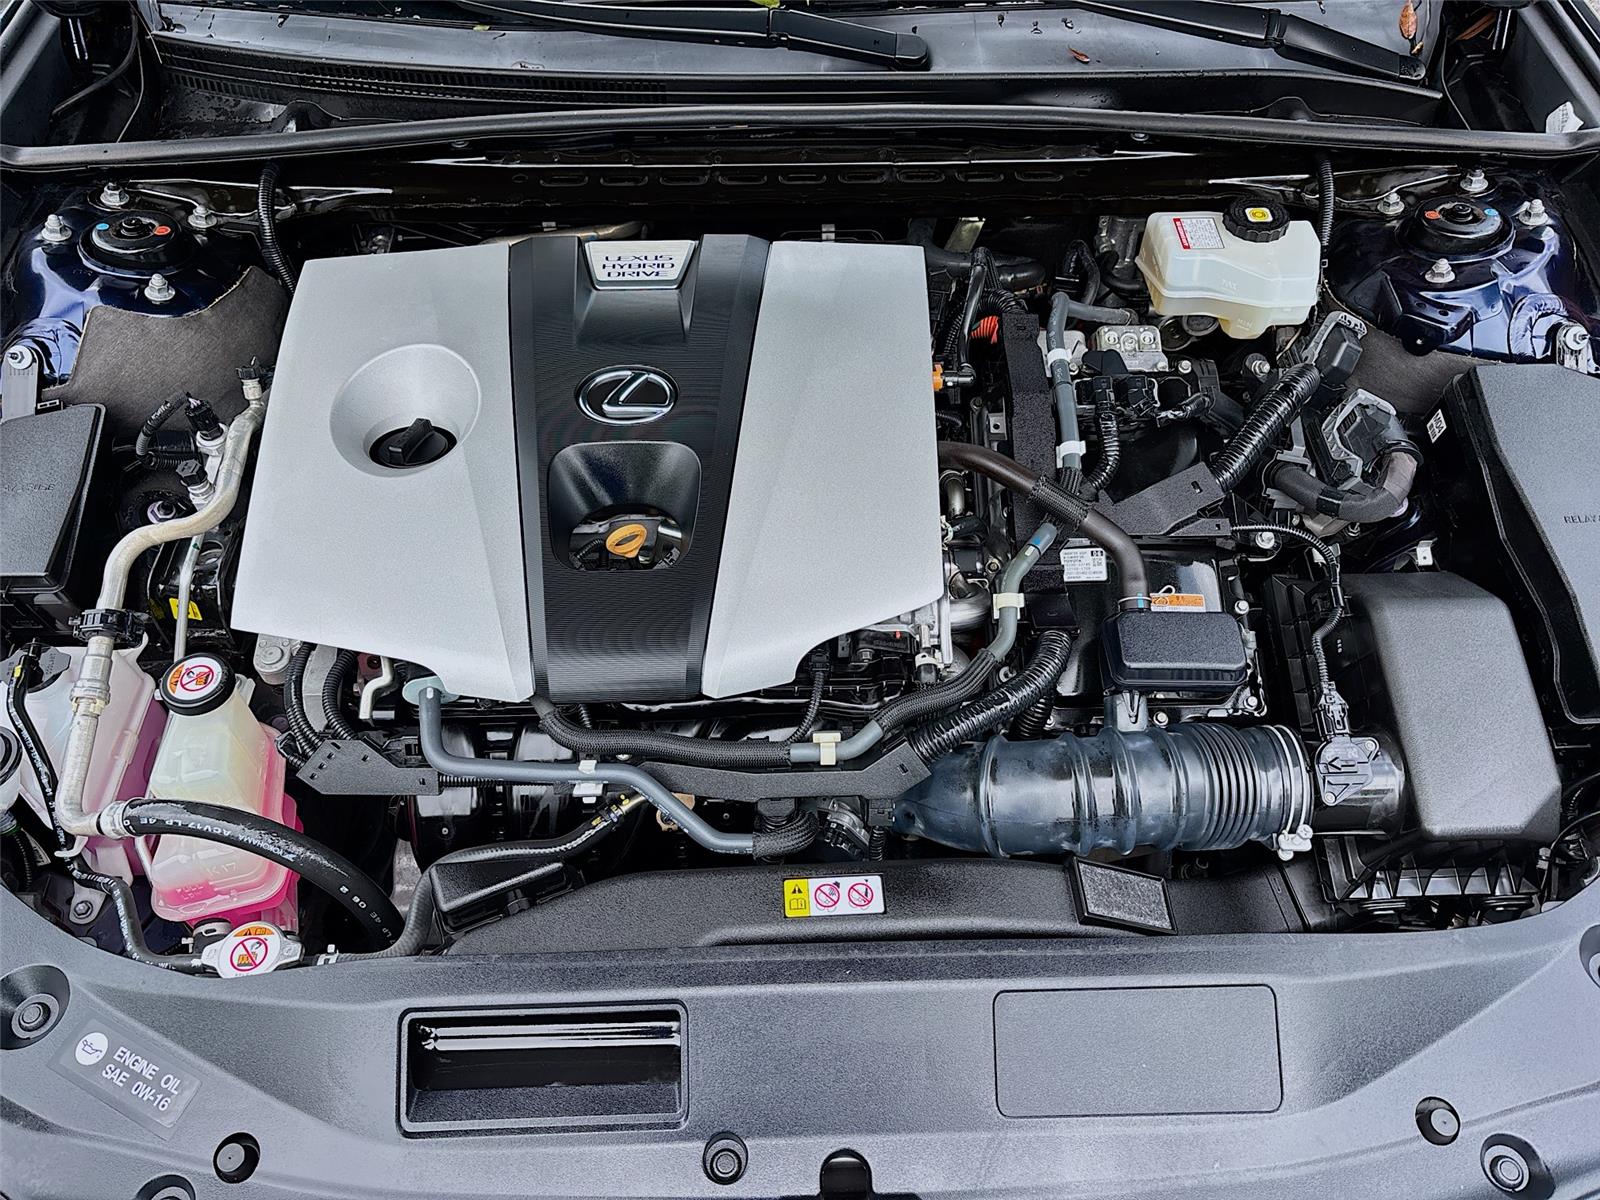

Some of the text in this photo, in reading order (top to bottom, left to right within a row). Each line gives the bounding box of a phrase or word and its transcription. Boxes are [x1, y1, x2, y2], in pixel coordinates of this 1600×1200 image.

[602, 262, 675, 270] HYBRID
[607, 270, 669, 278] DRIVE
[1563, 514, 1596, 524] RELAY
[238, 834, 287, 858] YOKOHAMA
[113, 1046, 181, 1095] ENGINE OIL
[102, 1063, 171, 1111] SAE 0W-16
